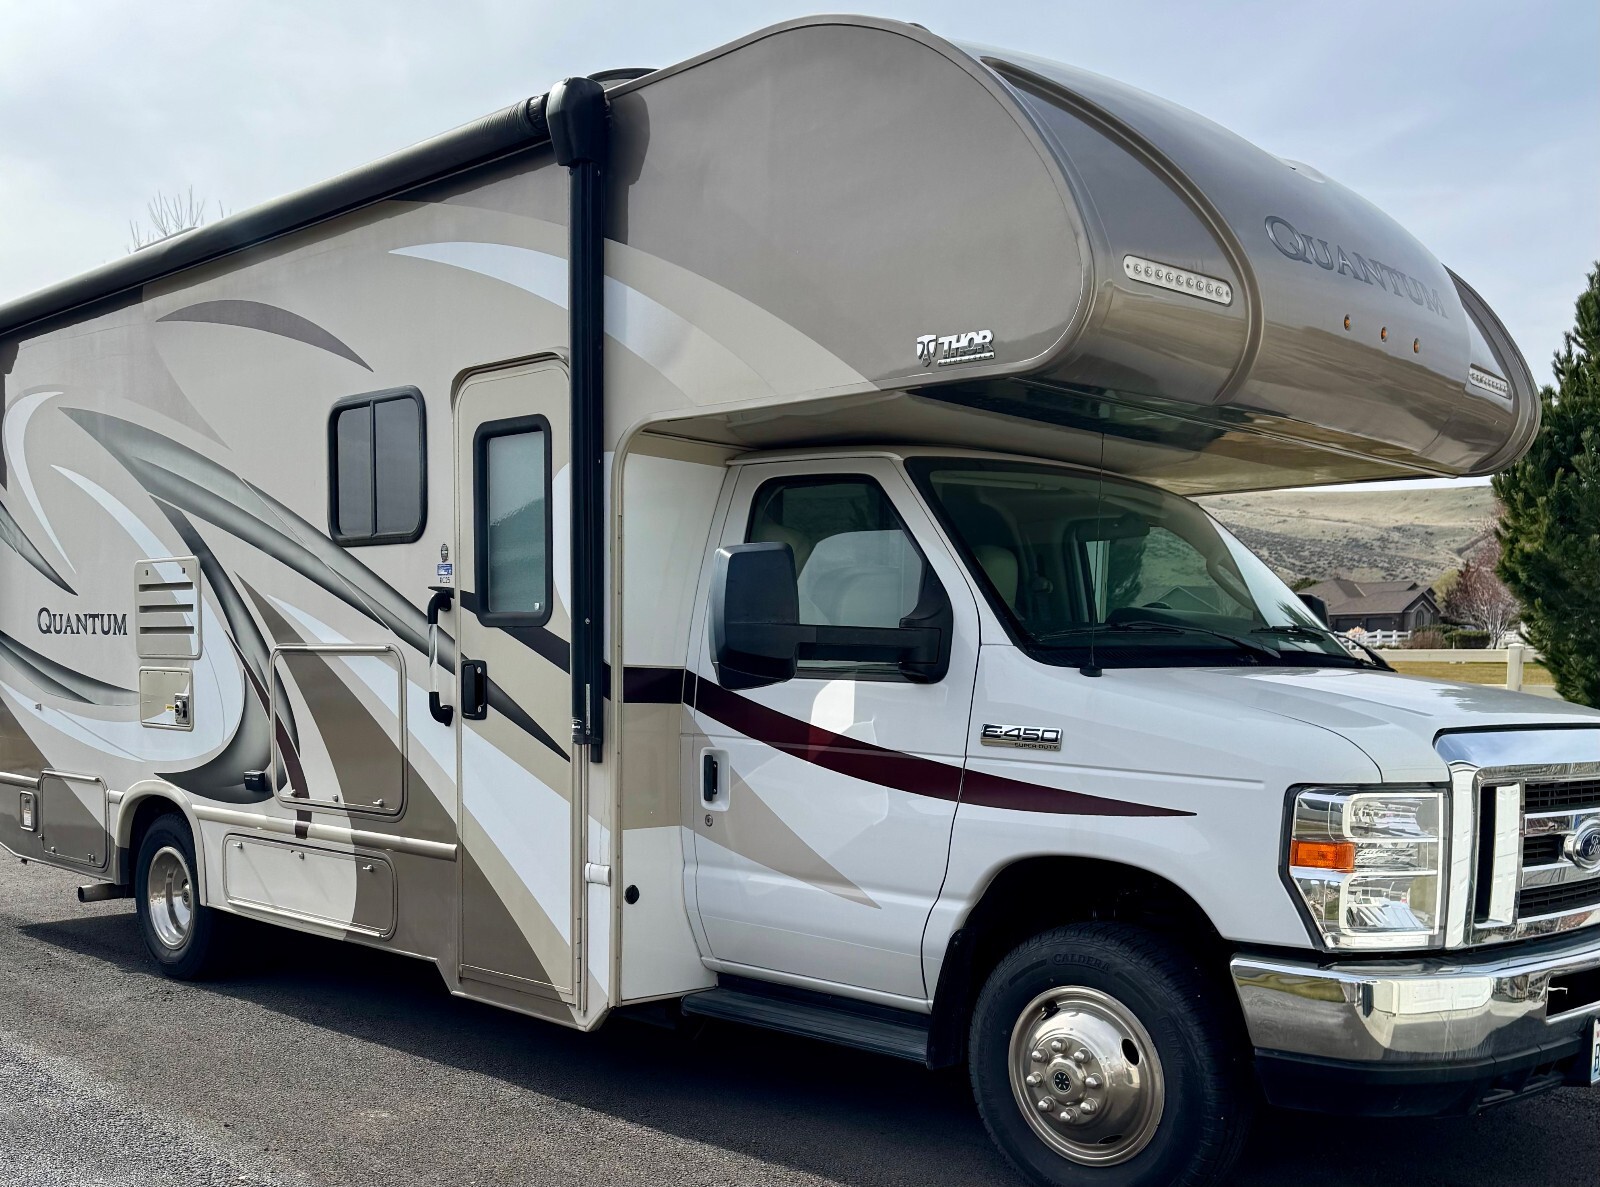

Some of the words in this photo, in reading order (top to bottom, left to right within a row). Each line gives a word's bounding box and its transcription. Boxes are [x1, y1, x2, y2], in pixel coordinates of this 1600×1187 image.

[1264, 215, 1449, 320] QUANTUM
[938, 329, 994, 360] THOR
[37, 607, 128, 636] QUANTUM
[1014, 742, 1037, 750] SUPER
[1038, 743, 1058, 751] DUTY
[1053, 952, 1111, 973] CALDERA
